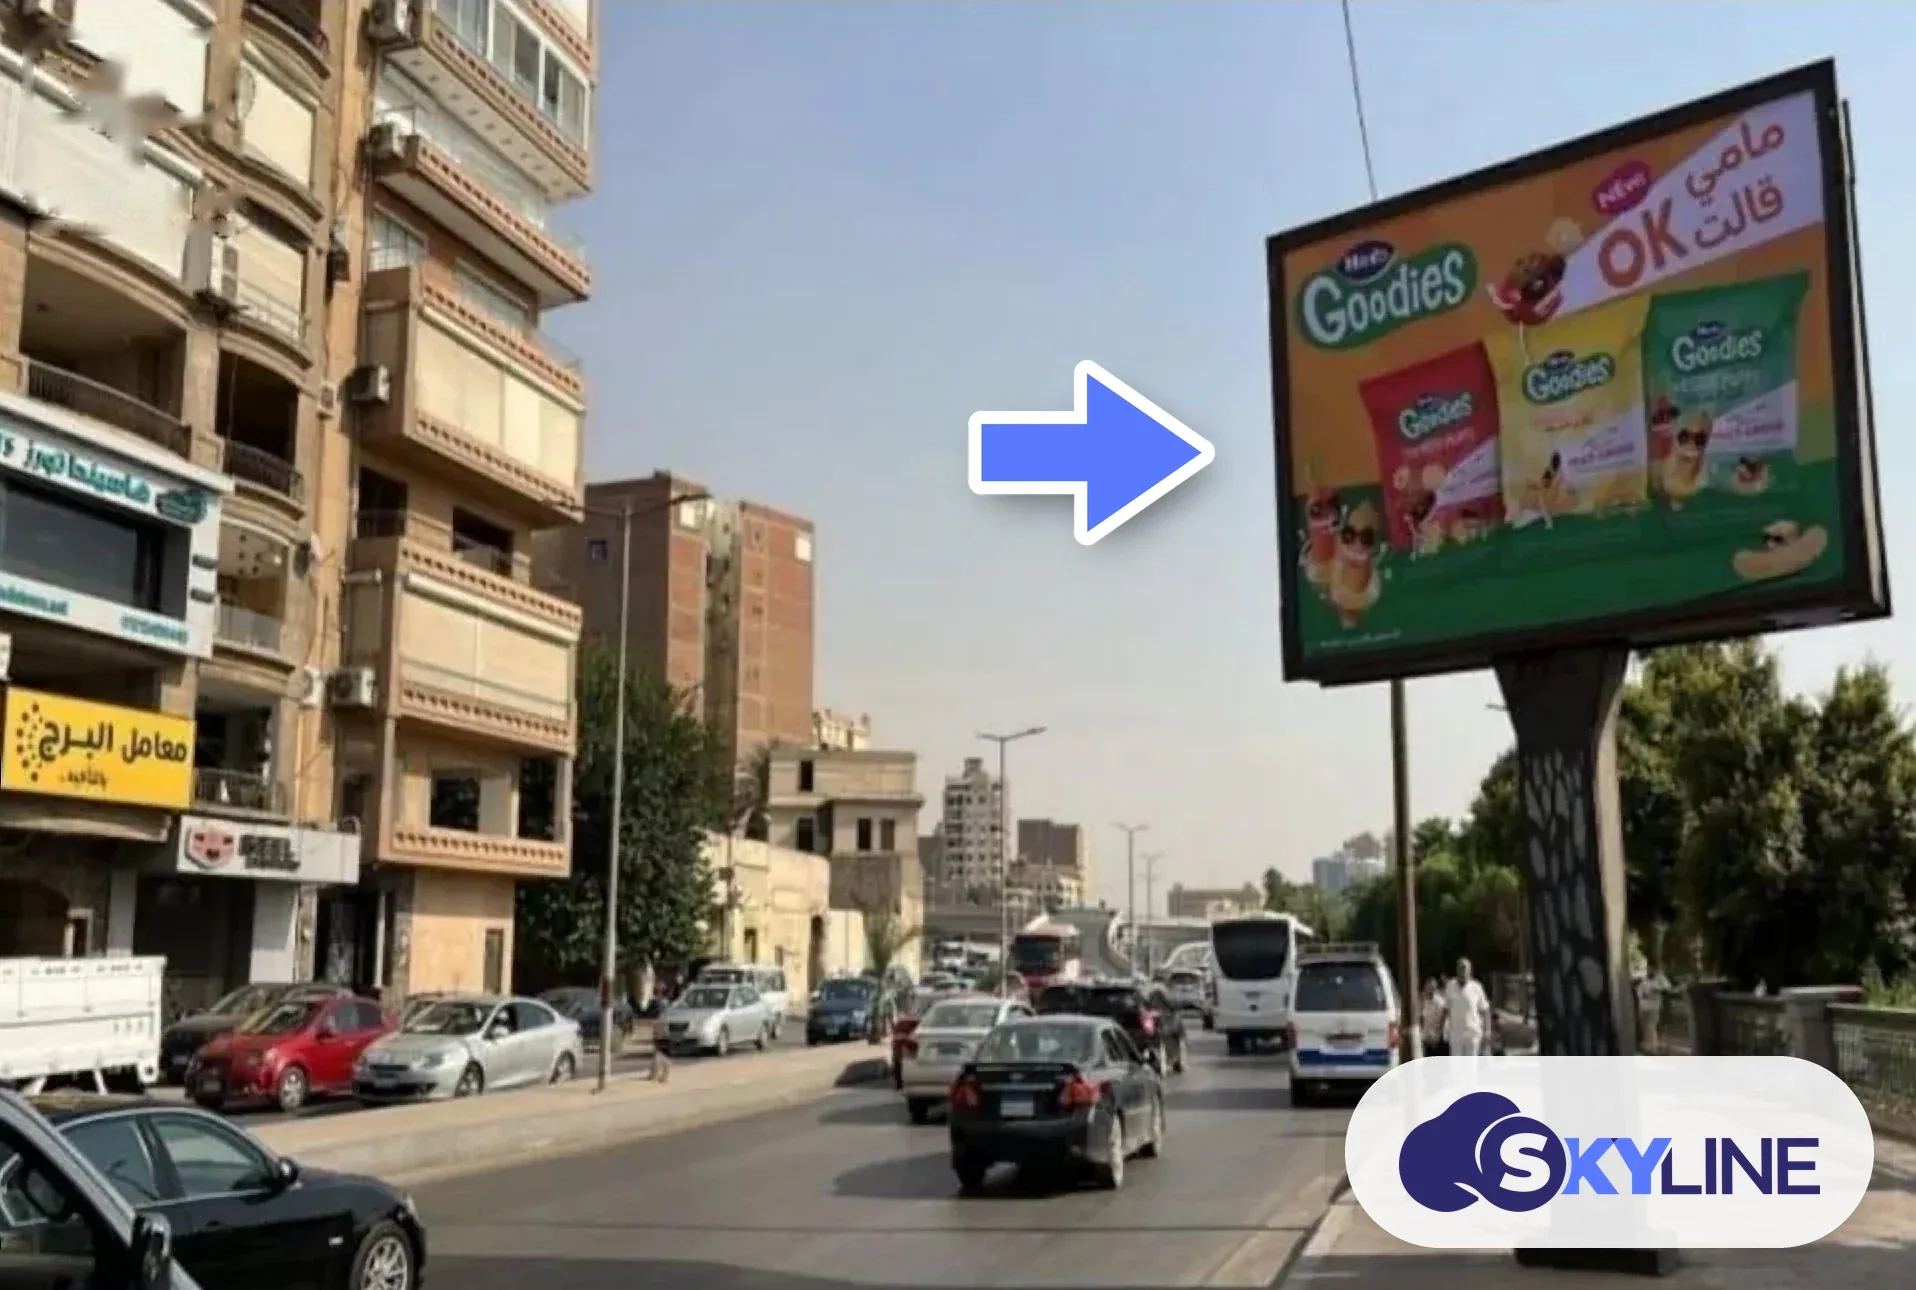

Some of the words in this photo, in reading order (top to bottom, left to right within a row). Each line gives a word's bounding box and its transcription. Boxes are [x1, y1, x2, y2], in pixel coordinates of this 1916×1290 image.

[1685, 121, 1786, 207] مامي
[1694, 173, 1785, 249] قالت
[1598, 197, 1690, 289] OK
[1303, 250, 1467, 344] Goodies
[1527, 356, 1609, 401] Goodies
[1672, 329, 1762, 372] Goodies
[38, 720, 114, 762] البرج
[122, 726, 188, 765] معامل
